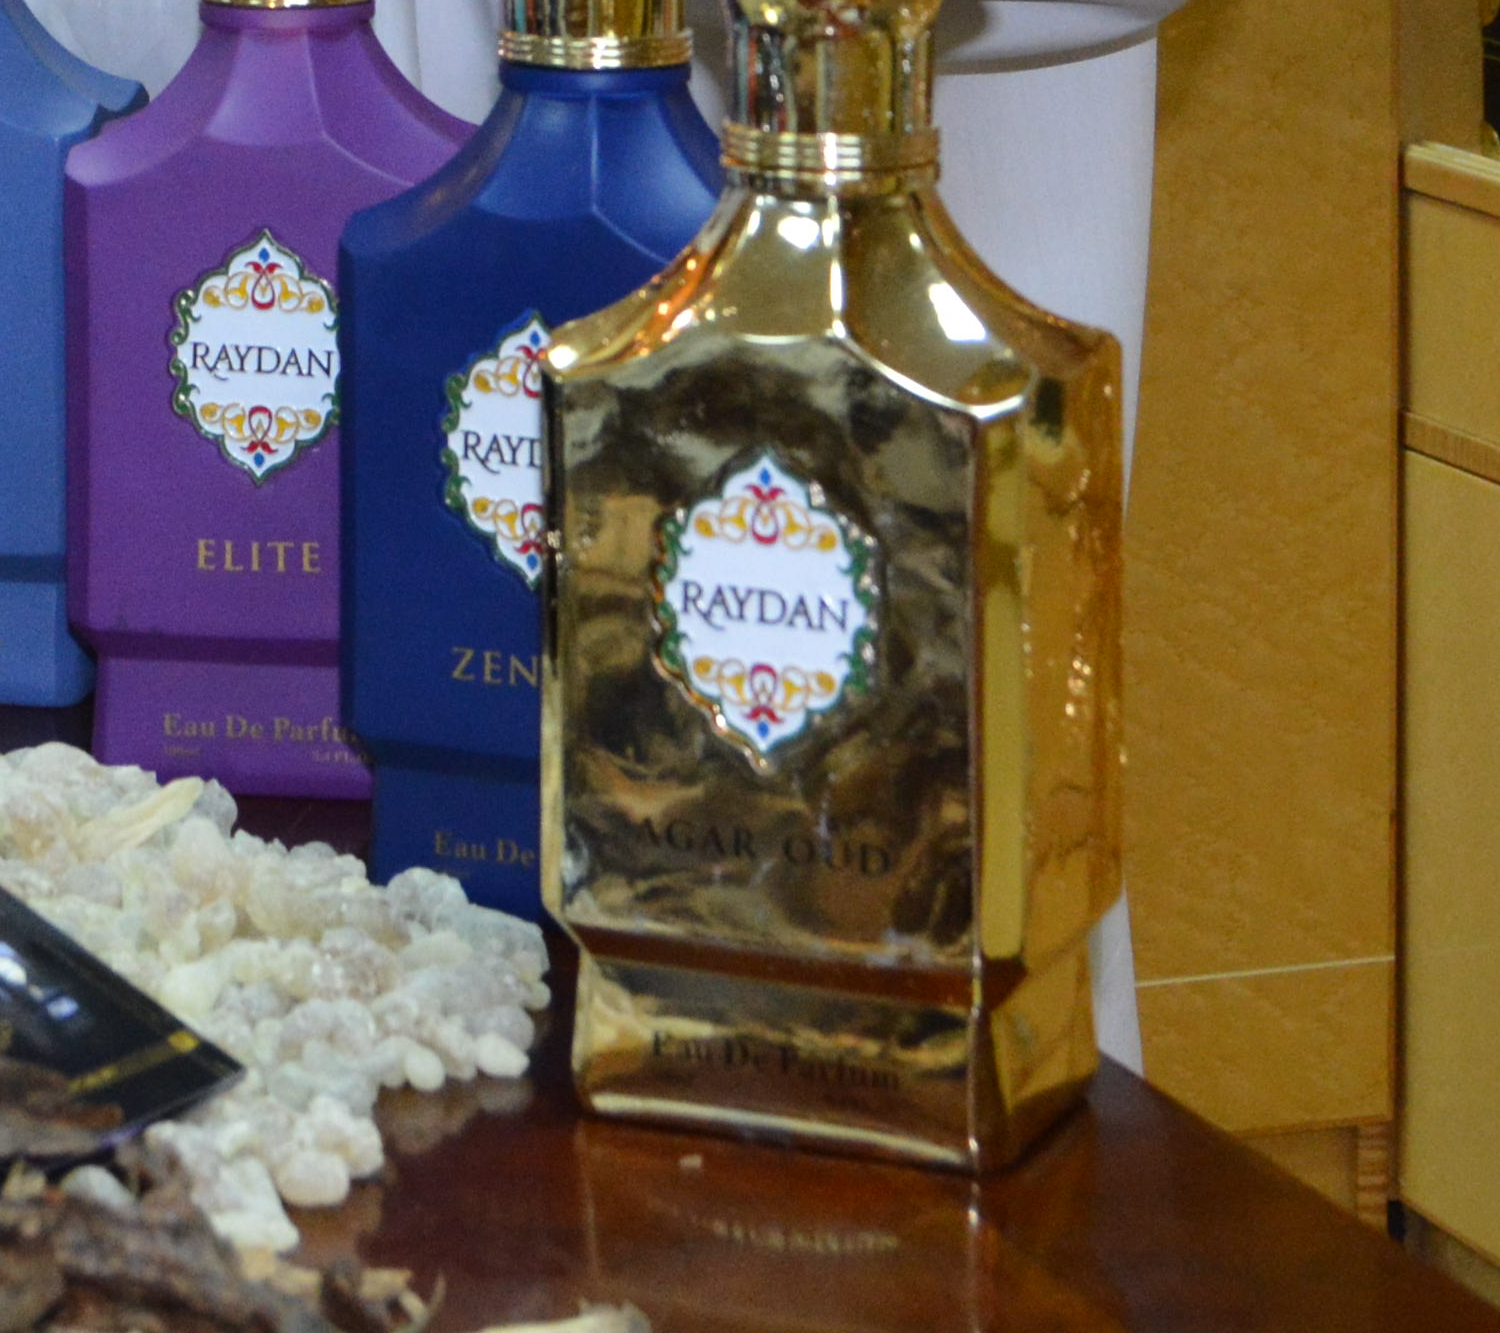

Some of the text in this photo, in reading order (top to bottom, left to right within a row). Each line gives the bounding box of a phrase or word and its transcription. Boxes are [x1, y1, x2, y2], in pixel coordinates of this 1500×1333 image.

[190, 344, 334, 380] RAYDAN
[461, 430, 541, 474] RAY
[197, 540, 323, 575] ELITE
[680, 578, 850, 633] RAYDAN
[452, 646, 539, 686] ZEN
[164, 712, 217, 737] Eau
[226, 714, 265, 739] De
[637, 816, 890, 877] AGAR OUD
